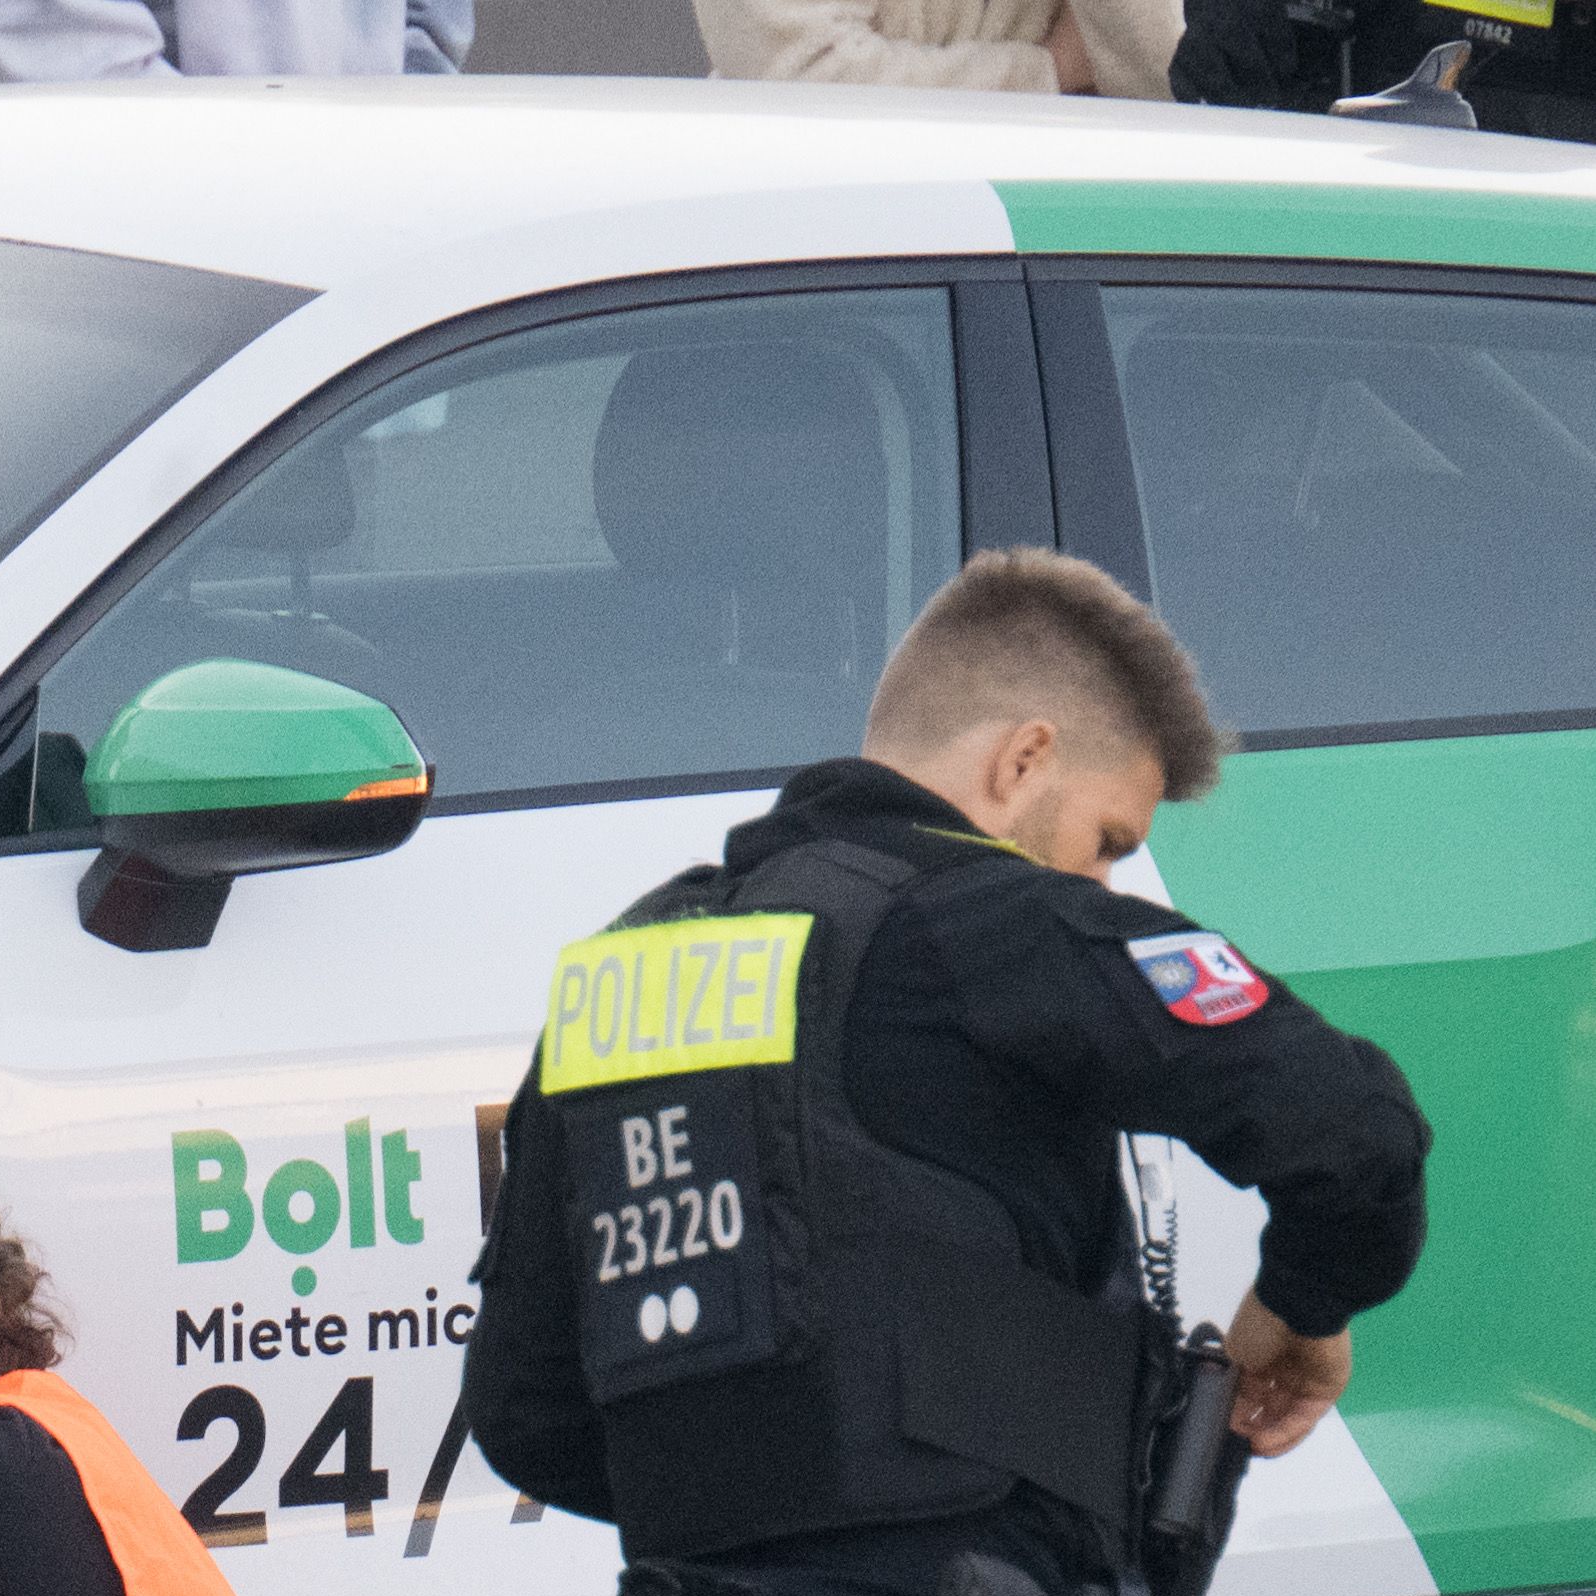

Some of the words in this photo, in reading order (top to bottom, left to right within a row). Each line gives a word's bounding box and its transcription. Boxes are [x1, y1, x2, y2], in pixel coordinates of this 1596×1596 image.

[552, 936, 787, 1068] POLIZEI
[171, 1115, 425, 1264] Bolt
[622, 1106, 693, 1190] BE
[594, 1179, 743, 1283] 23220
[175, 1302, 348, 1366] Miete
[367, 1287, 476, 1352] mic
[176, 1376, 547, 1558] 24/
